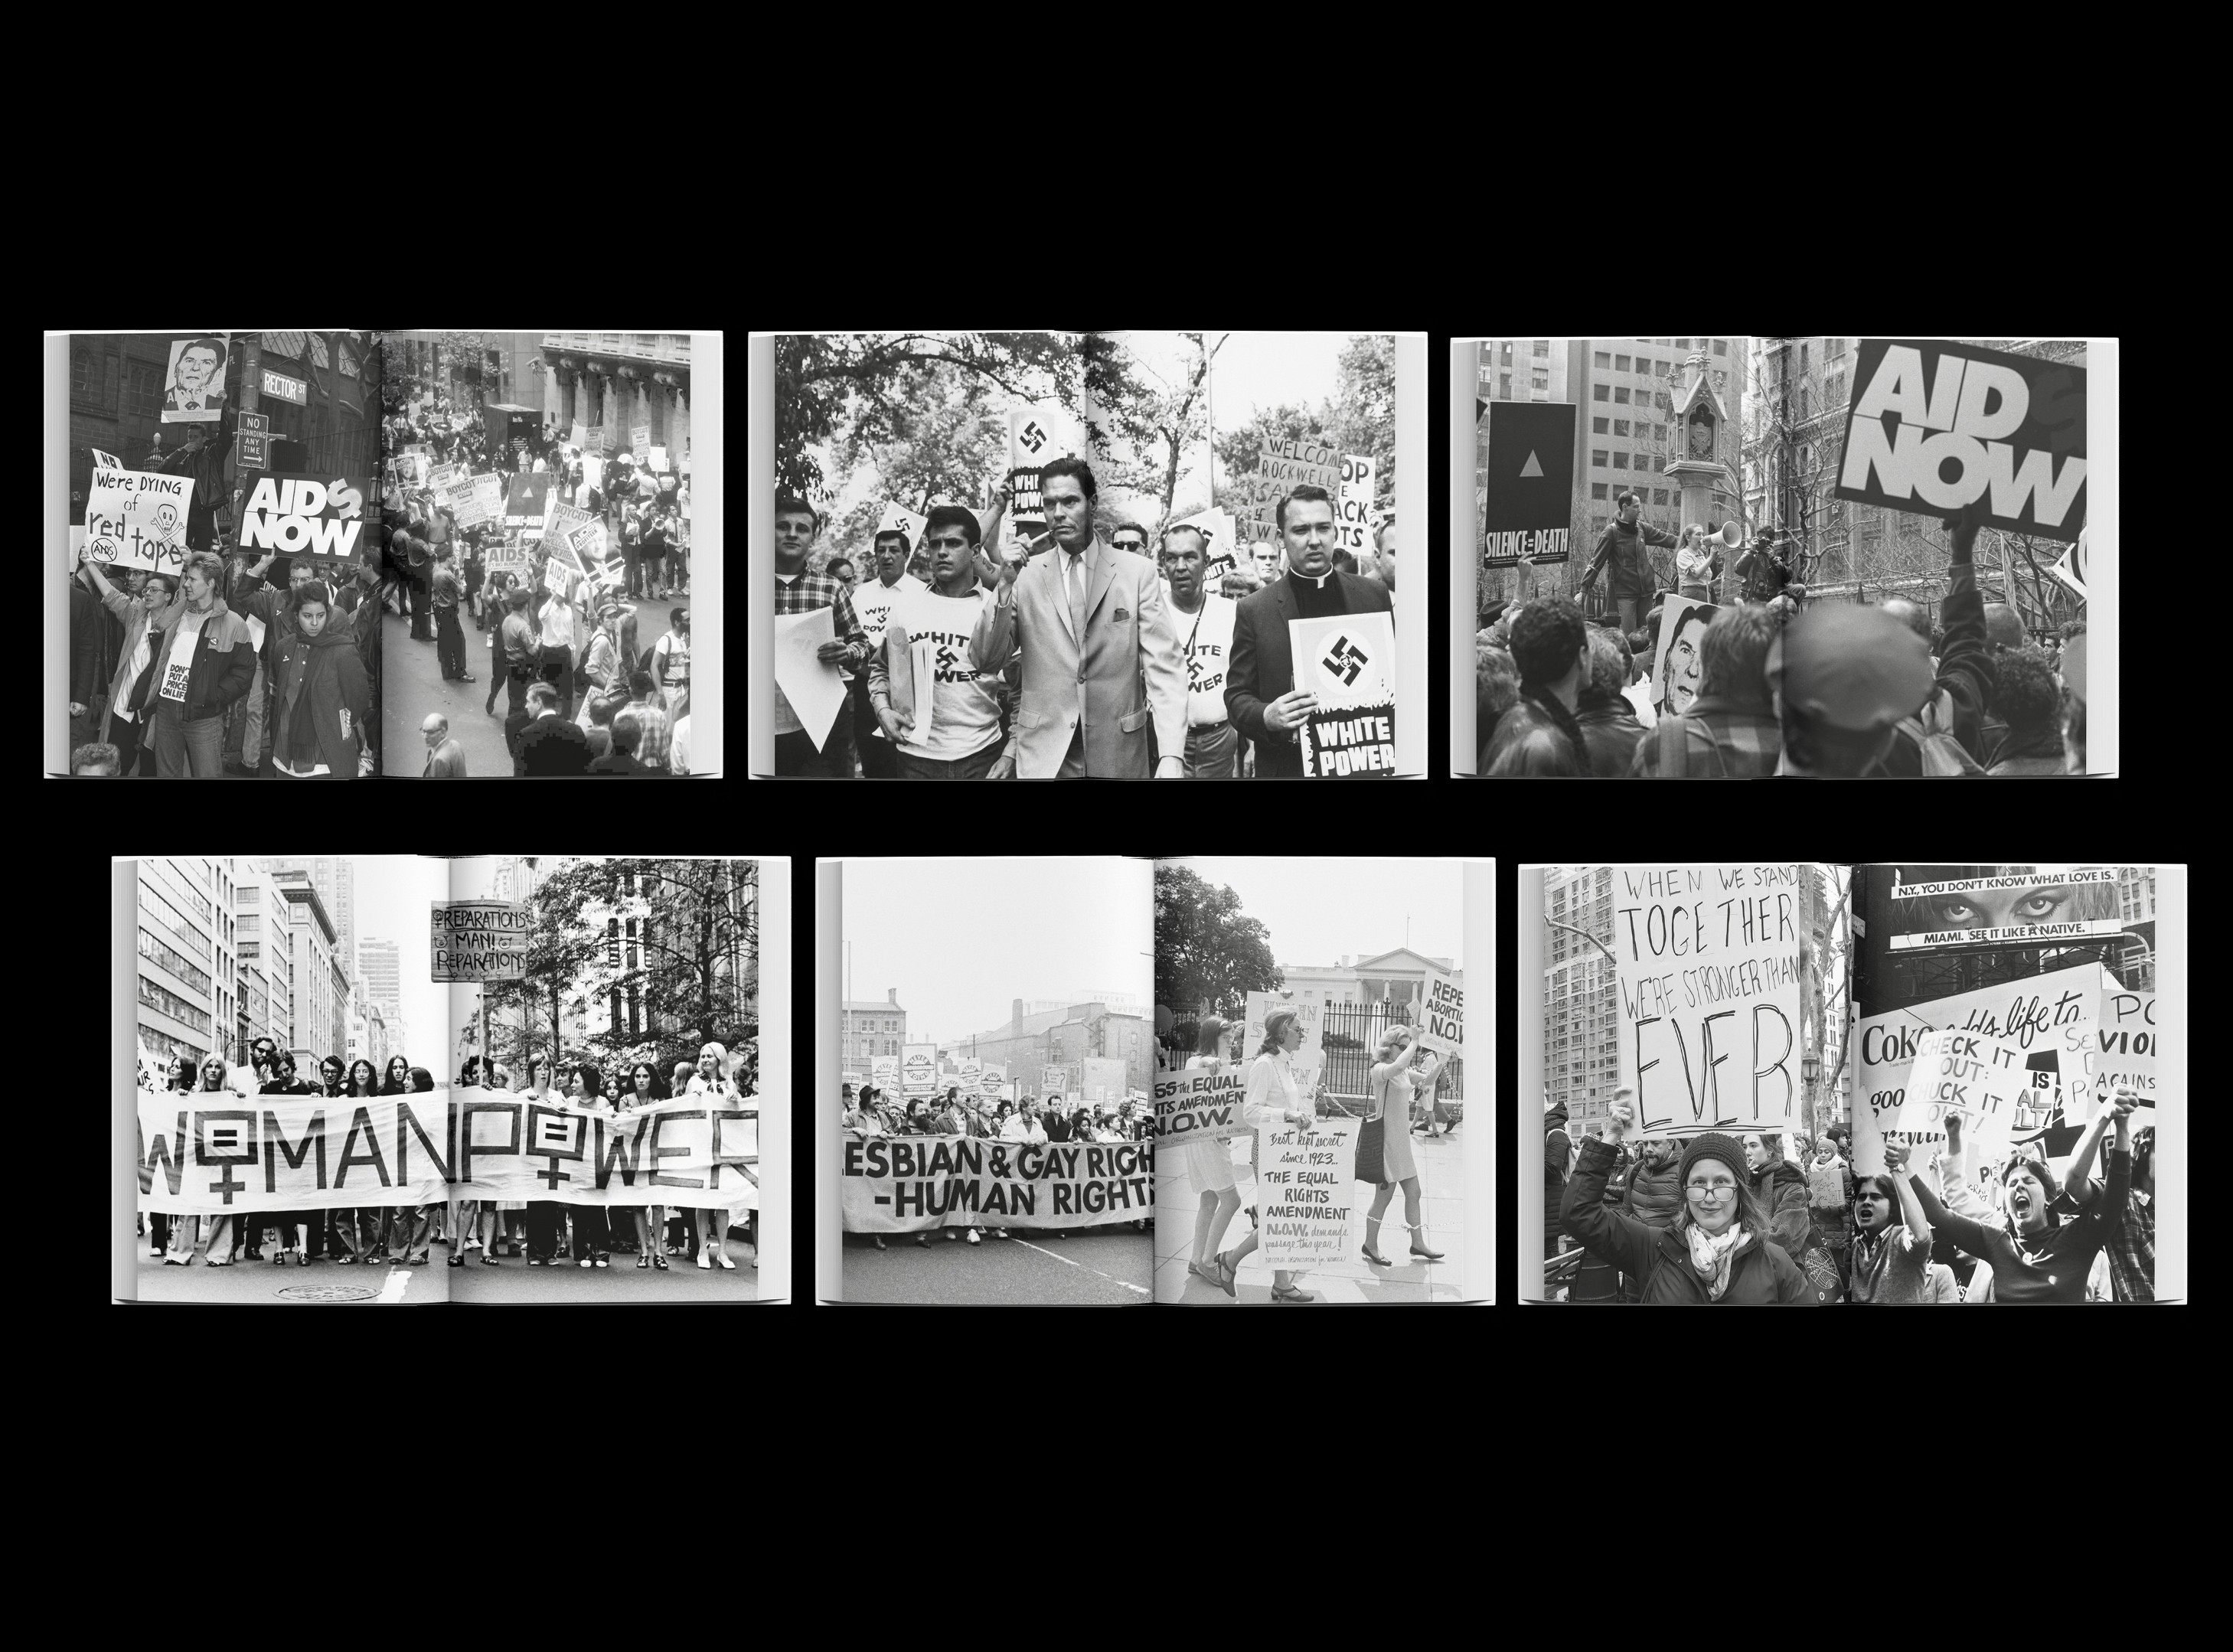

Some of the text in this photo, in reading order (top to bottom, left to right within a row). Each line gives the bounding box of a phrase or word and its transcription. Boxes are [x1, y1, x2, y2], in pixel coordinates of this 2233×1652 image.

[264, 372, 306, 400] RECTOR ST
[240, 428, 266, 439] STANDING
[246, 417, 260, 429] NO
[243, 445, 260, 455] TIME
[245, 437, 260, 446] ANY
[1269, 439, 1347, 469] WELCOME
[96, 472, 133, 491] We're
[1840, 414, 2088, 527] NOW
[123, 493, 142, 511] of
[90, 512, 126, 542] red
[240, 511, 363, 557] NOW
[573, 523, 596, 545] AIDS
[130, 527, 182, 573] tape
[575, 529, 598, 550] PROFITEER
[1485, 527, 1569, 559] SILENCE=DEATH
[488, 548, 527, 563] AIDS
[549, 562, 566, 583] AIDS
[166, 679, 188, 692] PRICE
[168, 671, 183, 681] PUT
[162, 687, 172, 697] ON
[1315, 716, 1391, 748] WHITE
[1319, 743, 1395, 777] POWER
[1624, 864, 1799, 901] WHEN WE STAND
[1898, 870, 2114, 896] N.Y., YOU DON'T KNOW WHAT LOVE IS.
[444, 909, 526, 930] REPARATIONS
[1618, 893, 1795, 962] TOGETHER
[455, 932, 495, 952] MAN!
[1924, 931, 1964, 945] MIAMI.
[1969, 929, 1987, 942] SEE
[1990, 929, 2000, 939] IT
[2002, 926, 2026, 939] LIKE
[2039, 922, 2085, 935] NATIVE.
[436, 949, 526, 975] REPARATIONS
[1621, 955, 1800, 1020] WE'RE STRONGER THAN
[1999, 995, 2050, 1050] life
[1920, 1036, 2016, 1069] CHECK IT
[1634, 1003, 1793, 1131] EVER
[1940, 1056, 1990, 1082] OUT:
[1177, 1081, 1191, 1094] the
[1192, 1074, 1245, 1094] EQUAL
[2031, 1071, 2049, 1089] IS
[1177, 1090, 1247, 1112] AMENDMEN
[1908, 1082, 2003, 1114] CHUCK IT
[1269, 1128, 1348, 1151] Best kept secret
[842, 1140, 982, 1179] ESBIAN
[988, 1145, 1011, 1179] &
[1017, 1146, 1080, 1180] GAY
[1279, 1151, 1307, 1164] since
[1264, 1170, 1339, 1187] THE EQUAL
[1285, 1187, 1330, 1204] RIGHTS
[1266, 1205, 1351, 1221] AMENDMENT
[1266, 1223, 1349, 1237] N.O.W. demands
[1265, 1239, 1299, 1254] passage
[1297, 1237, 1313, 1249] this
